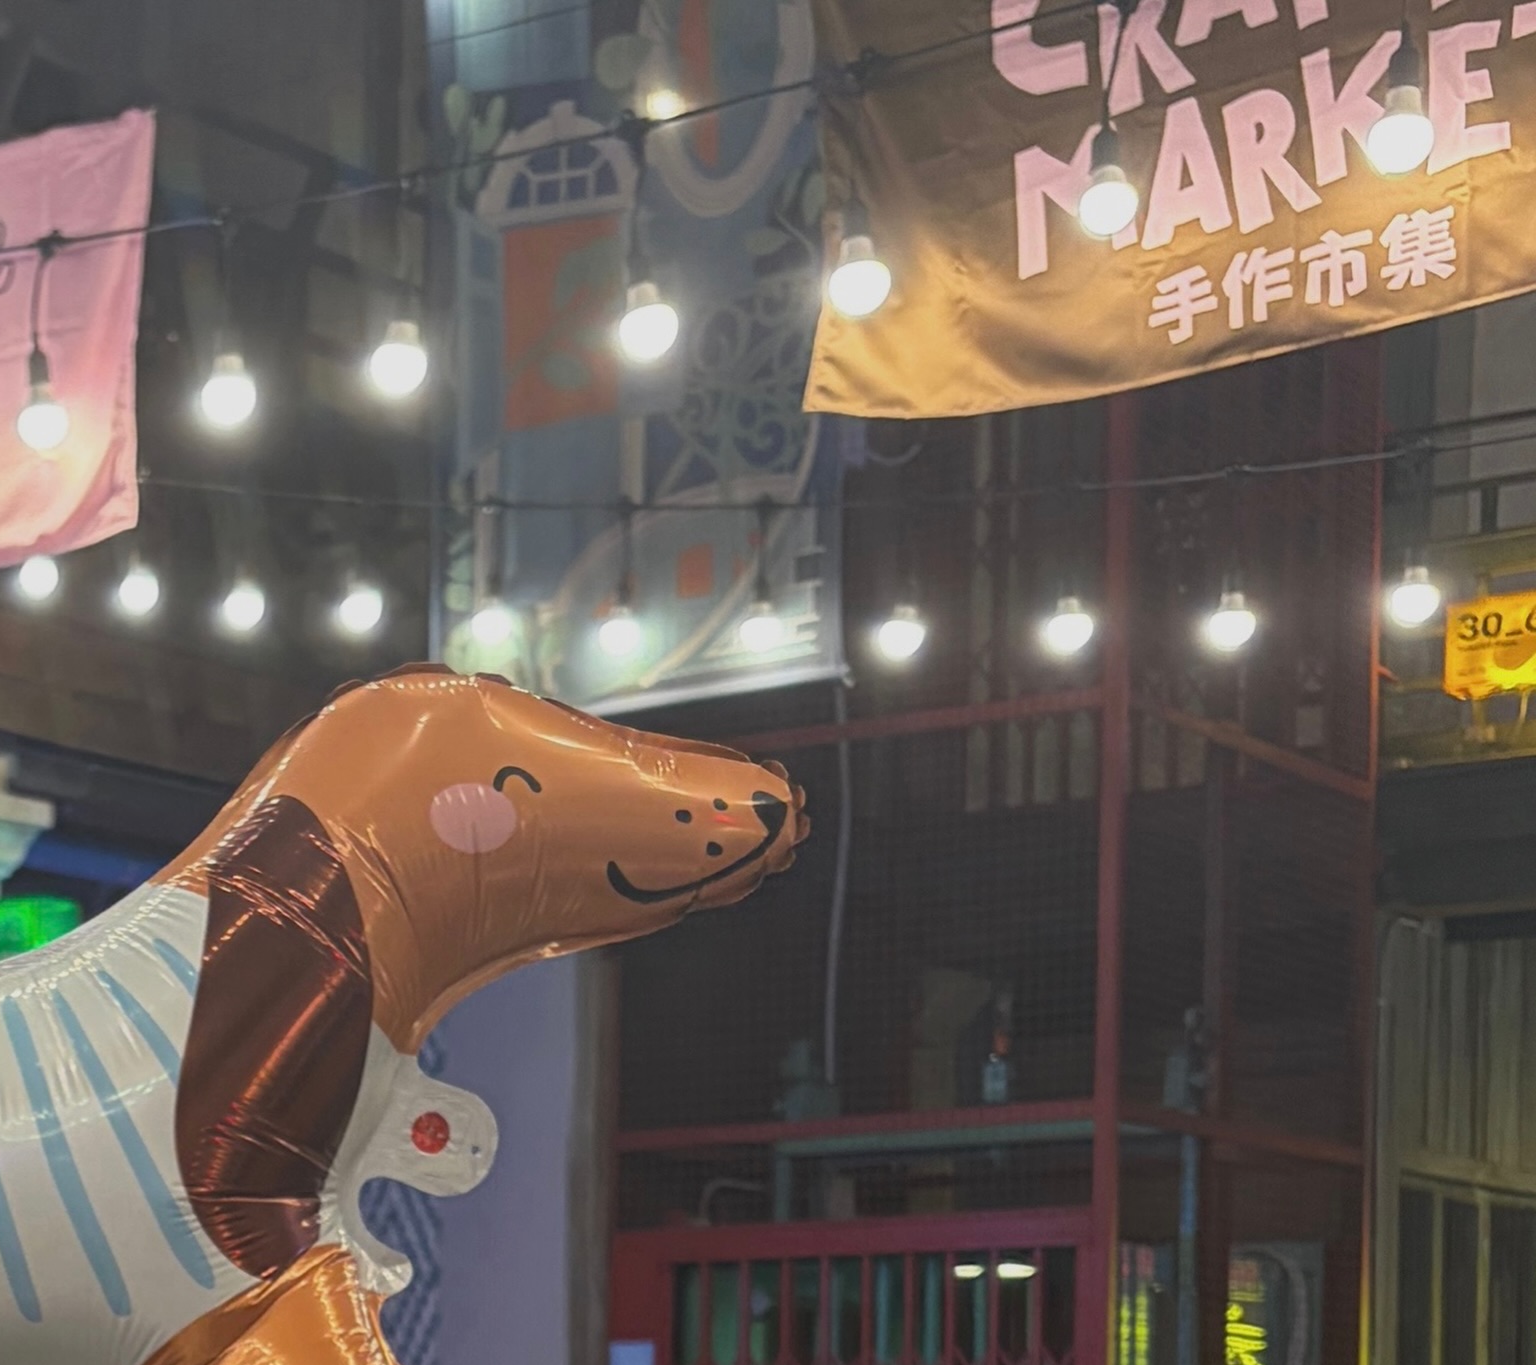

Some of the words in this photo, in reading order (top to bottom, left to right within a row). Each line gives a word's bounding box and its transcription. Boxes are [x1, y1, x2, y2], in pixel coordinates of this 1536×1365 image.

[1014, 2, 1536, 280] MARKE
[1148, 205, 1457, 345] 手作市集
